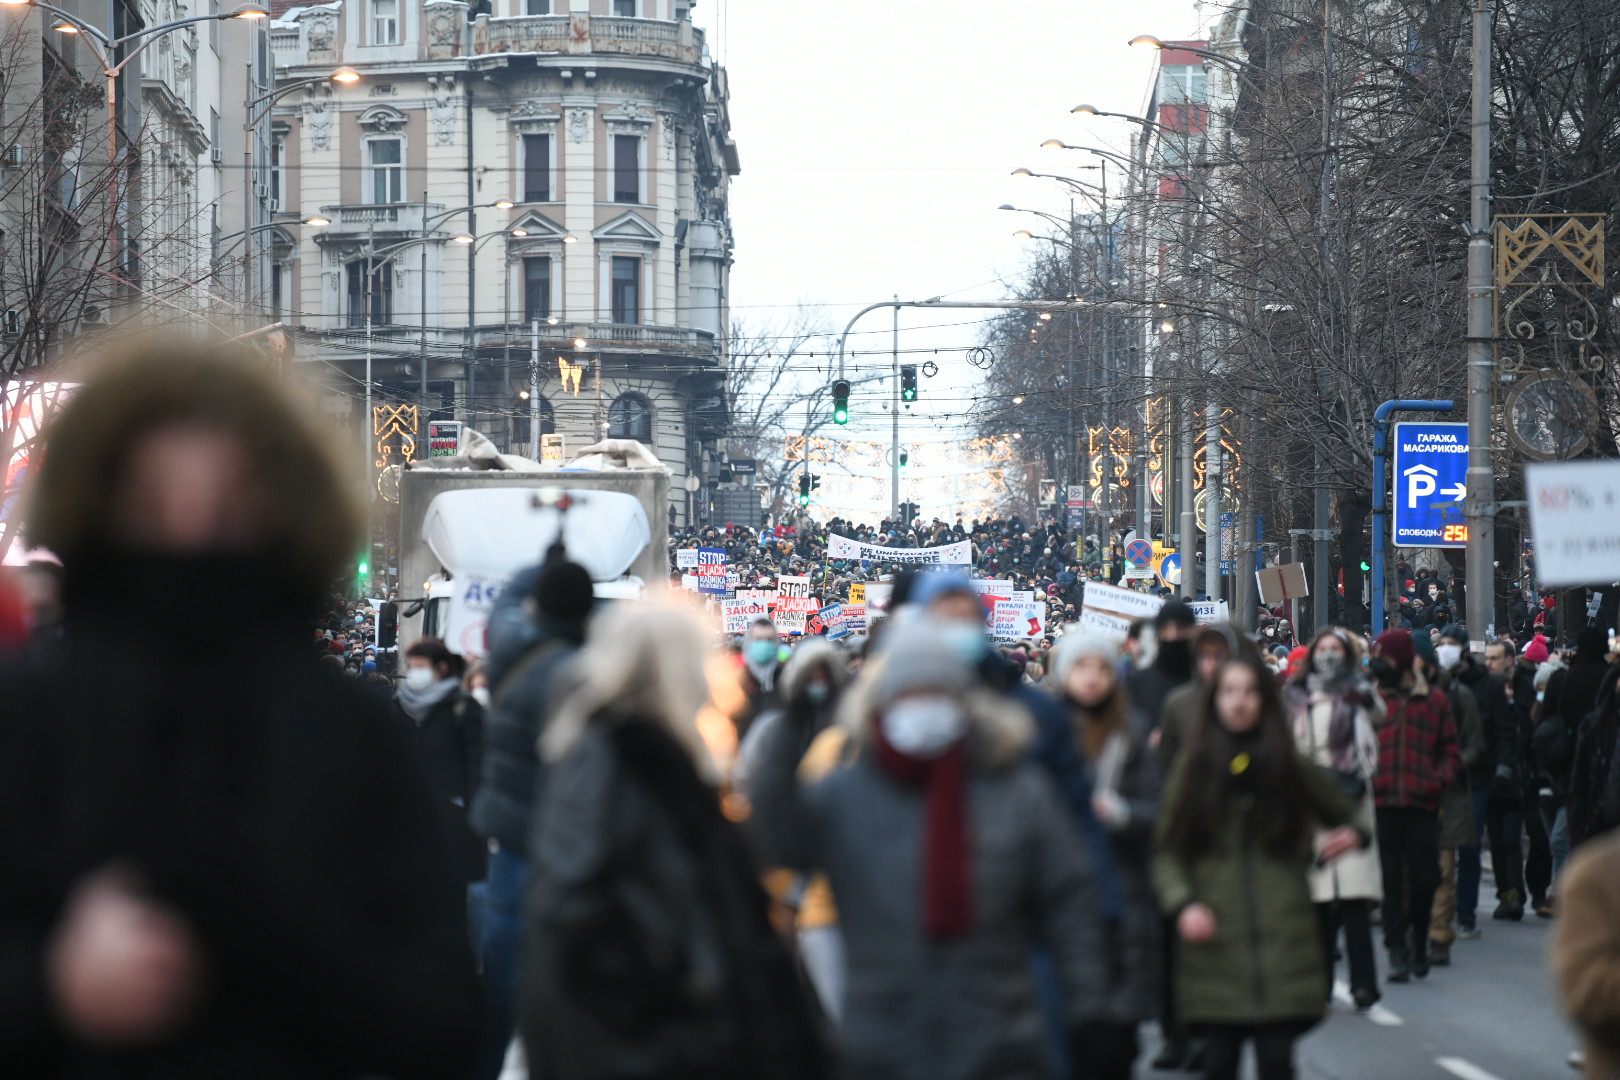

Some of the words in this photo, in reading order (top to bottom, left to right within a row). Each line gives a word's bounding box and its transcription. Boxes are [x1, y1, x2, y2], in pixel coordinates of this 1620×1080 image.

[1417, 434, 1457, 442] ГАРАЖА
[1403, 444, 1470, 453] МАСАРИКОВА
[699, 552, 726, 565] STOP
[779, 582, 808, 598] STOP
[725, 604, 765, 616] ЗАКОН
